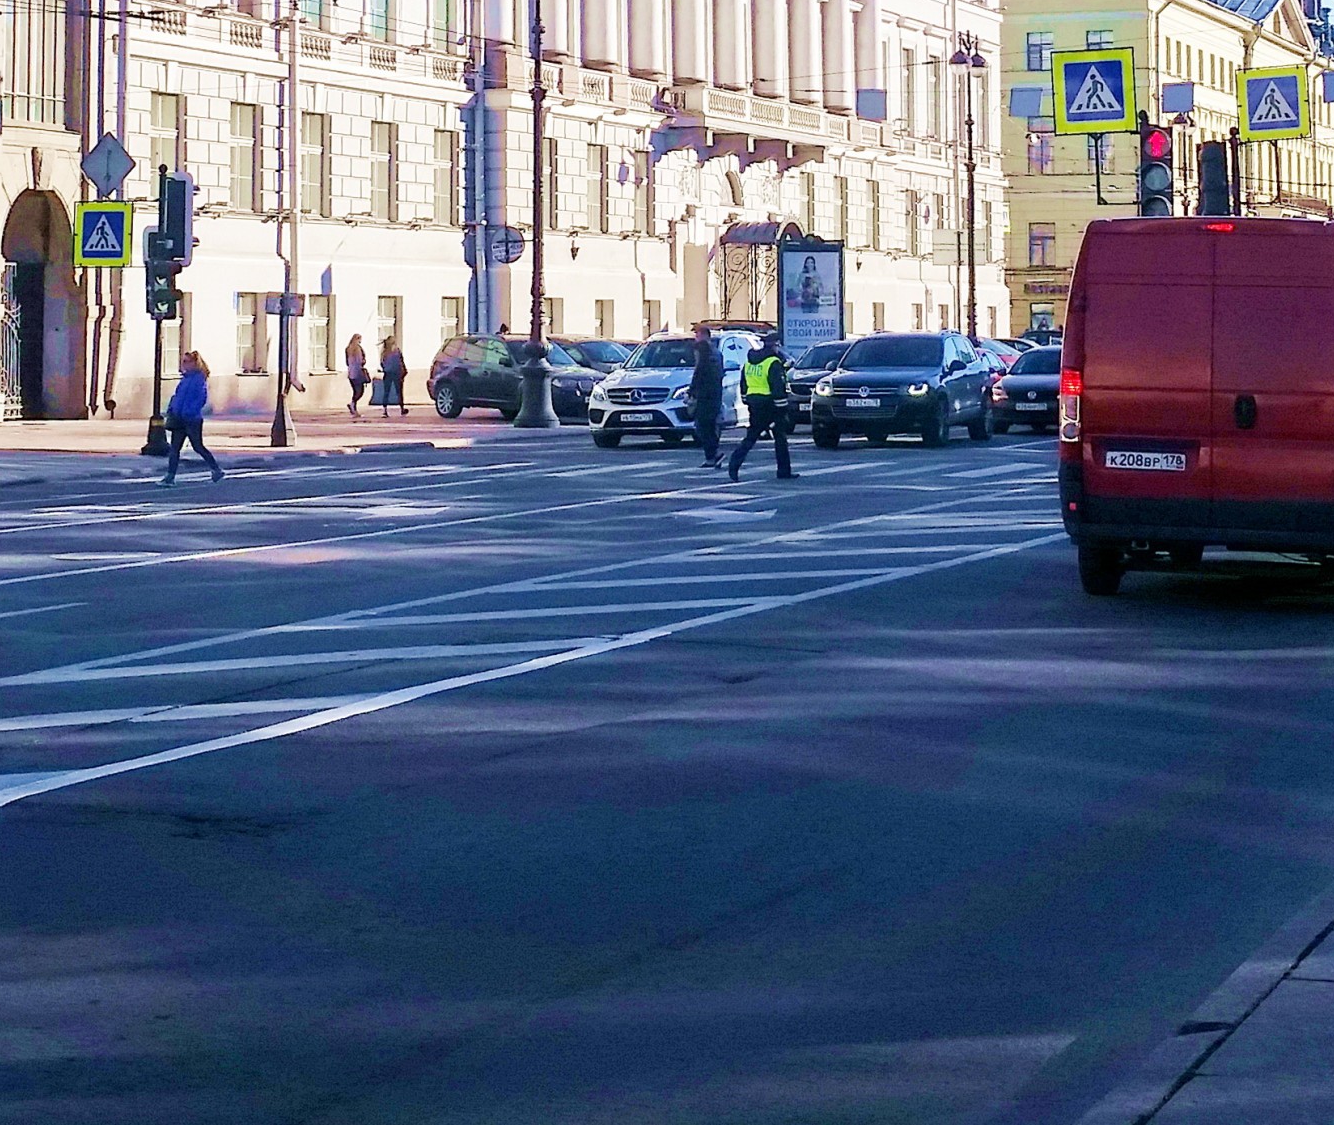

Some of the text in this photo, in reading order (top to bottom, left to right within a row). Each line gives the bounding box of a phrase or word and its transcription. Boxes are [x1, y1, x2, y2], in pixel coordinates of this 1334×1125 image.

[787, 318, 835, 328] ОТКРОЙТЕ
[787, 328, 836, 337] СВОЙ МИР
[1110, 454, 1182, 467] К208ВР 178
